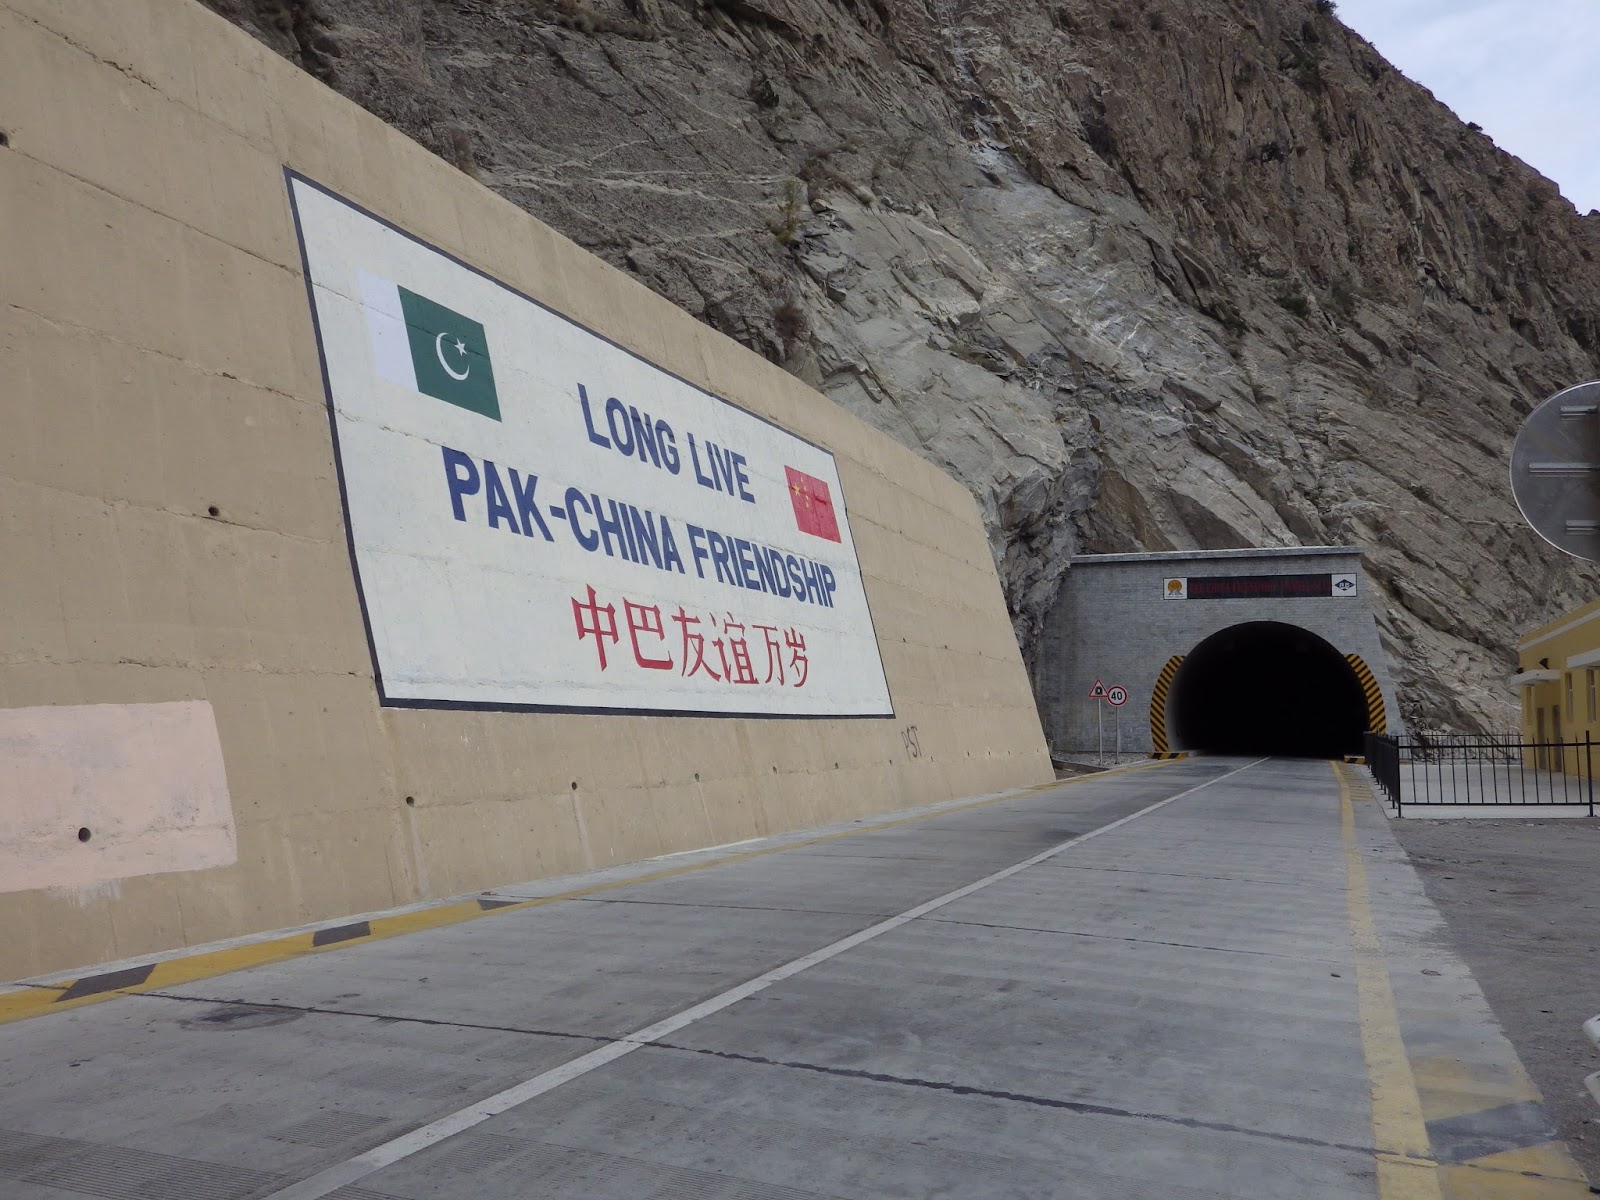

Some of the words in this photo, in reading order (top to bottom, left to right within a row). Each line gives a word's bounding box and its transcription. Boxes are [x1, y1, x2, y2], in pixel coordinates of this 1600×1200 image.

[577, 383, 682, 476] LONG
[688, 432, 755, 503] LIVE
[441, 446, 684, 575] PAK-CHINA
[686, 524, 836, 608] FRIENDSHIP
[571, 584, 809, 688] 中巴友谊万岁
[1110, 691, 1123, 701] 40
